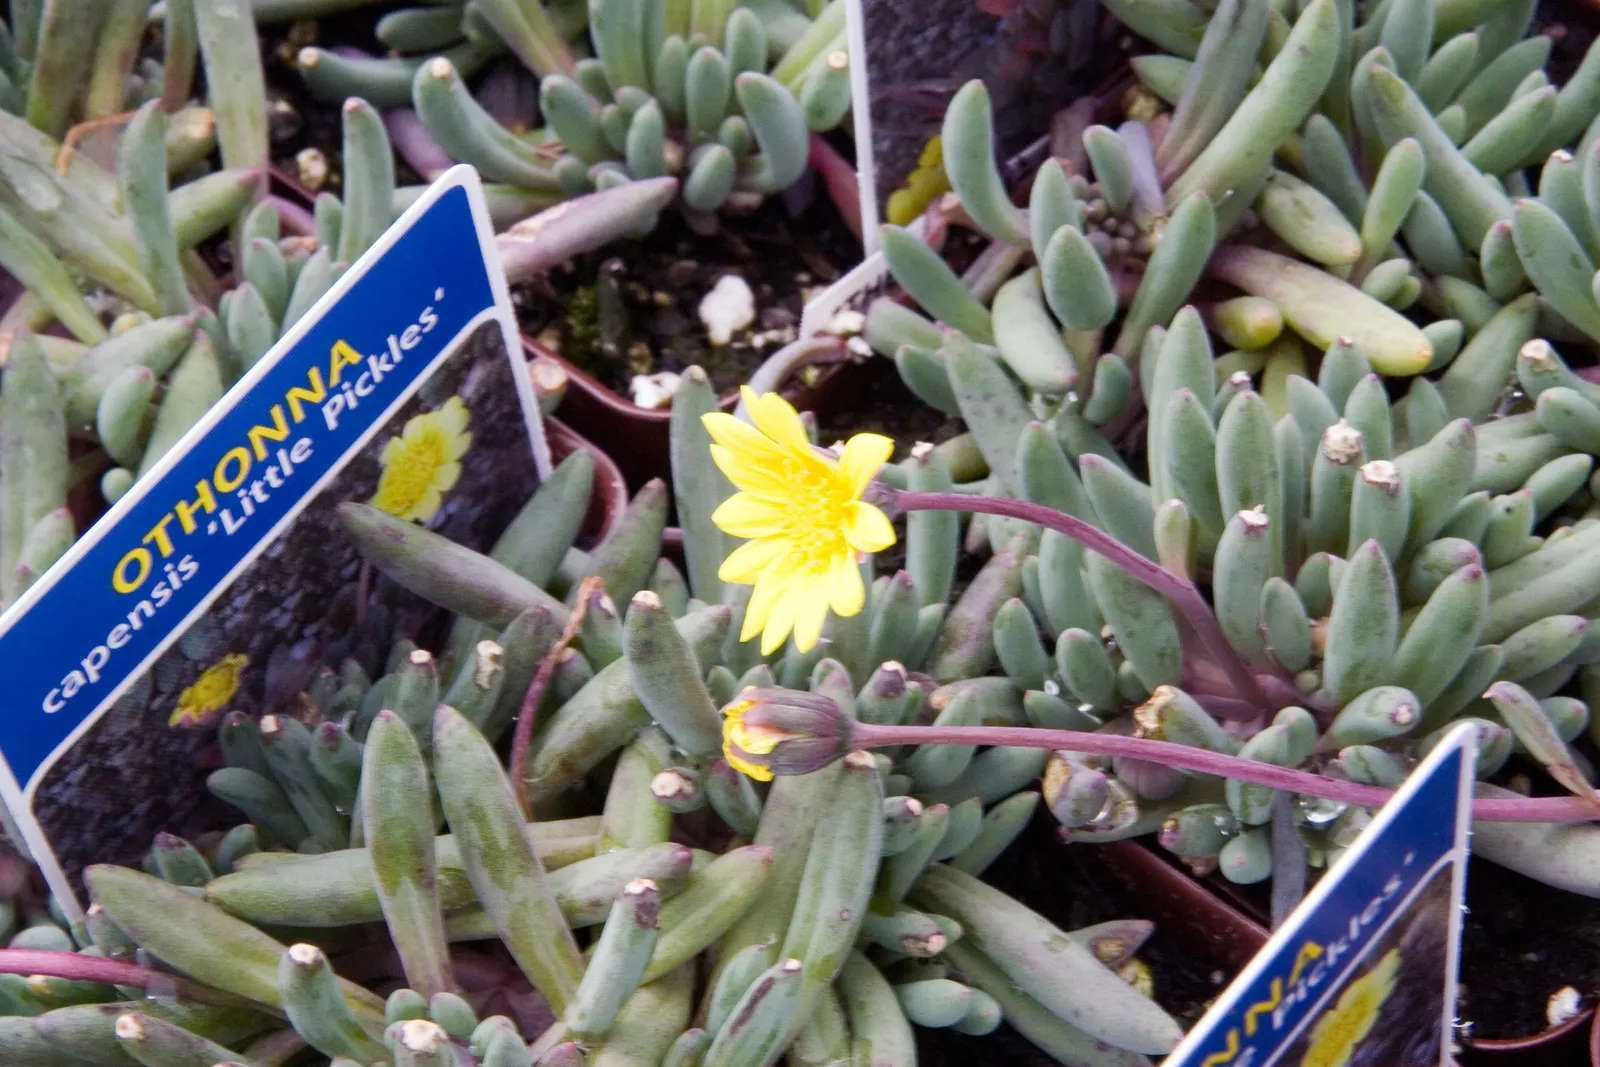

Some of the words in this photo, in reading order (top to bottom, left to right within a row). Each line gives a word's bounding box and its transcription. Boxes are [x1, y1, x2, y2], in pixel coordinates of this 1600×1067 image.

[42, 554, 200, 715] capensis
[207, 437, 314, 536] 'Little
[321, 286, 446, 431] Pickles'
[112, 339, 364, 595] OTHONNA
